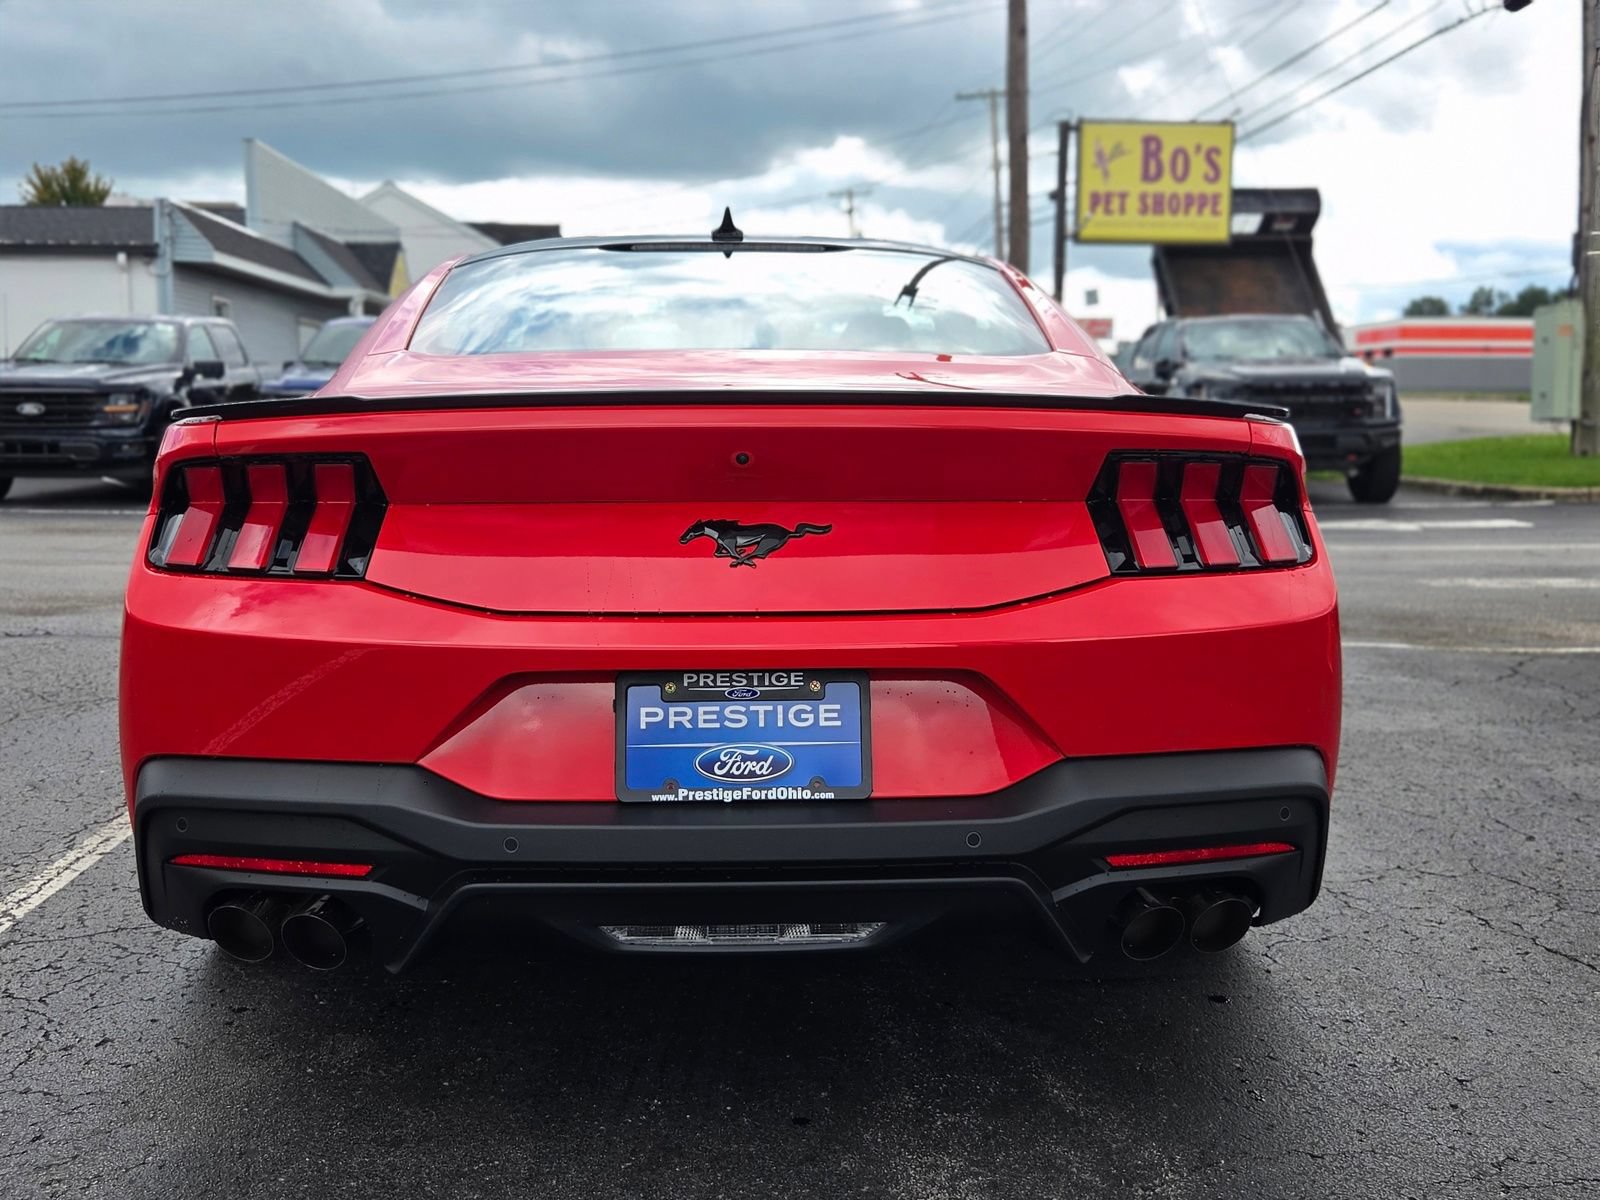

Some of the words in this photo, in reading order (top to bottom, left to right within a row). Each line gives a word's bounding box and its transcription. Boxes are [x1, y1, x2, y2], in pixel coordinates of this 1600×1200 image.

[1089, 191, 1129, 217] PET
[1138, 191, 1222, 217] SHOPPE
[683, 672, 804, 687] PRESTIGE
[639, 704, 842, 730] PRESTIGE
[713, 748, 773, 776] Ford
[651, 787, 835, 802] www.PrestigeFordOhio.com
